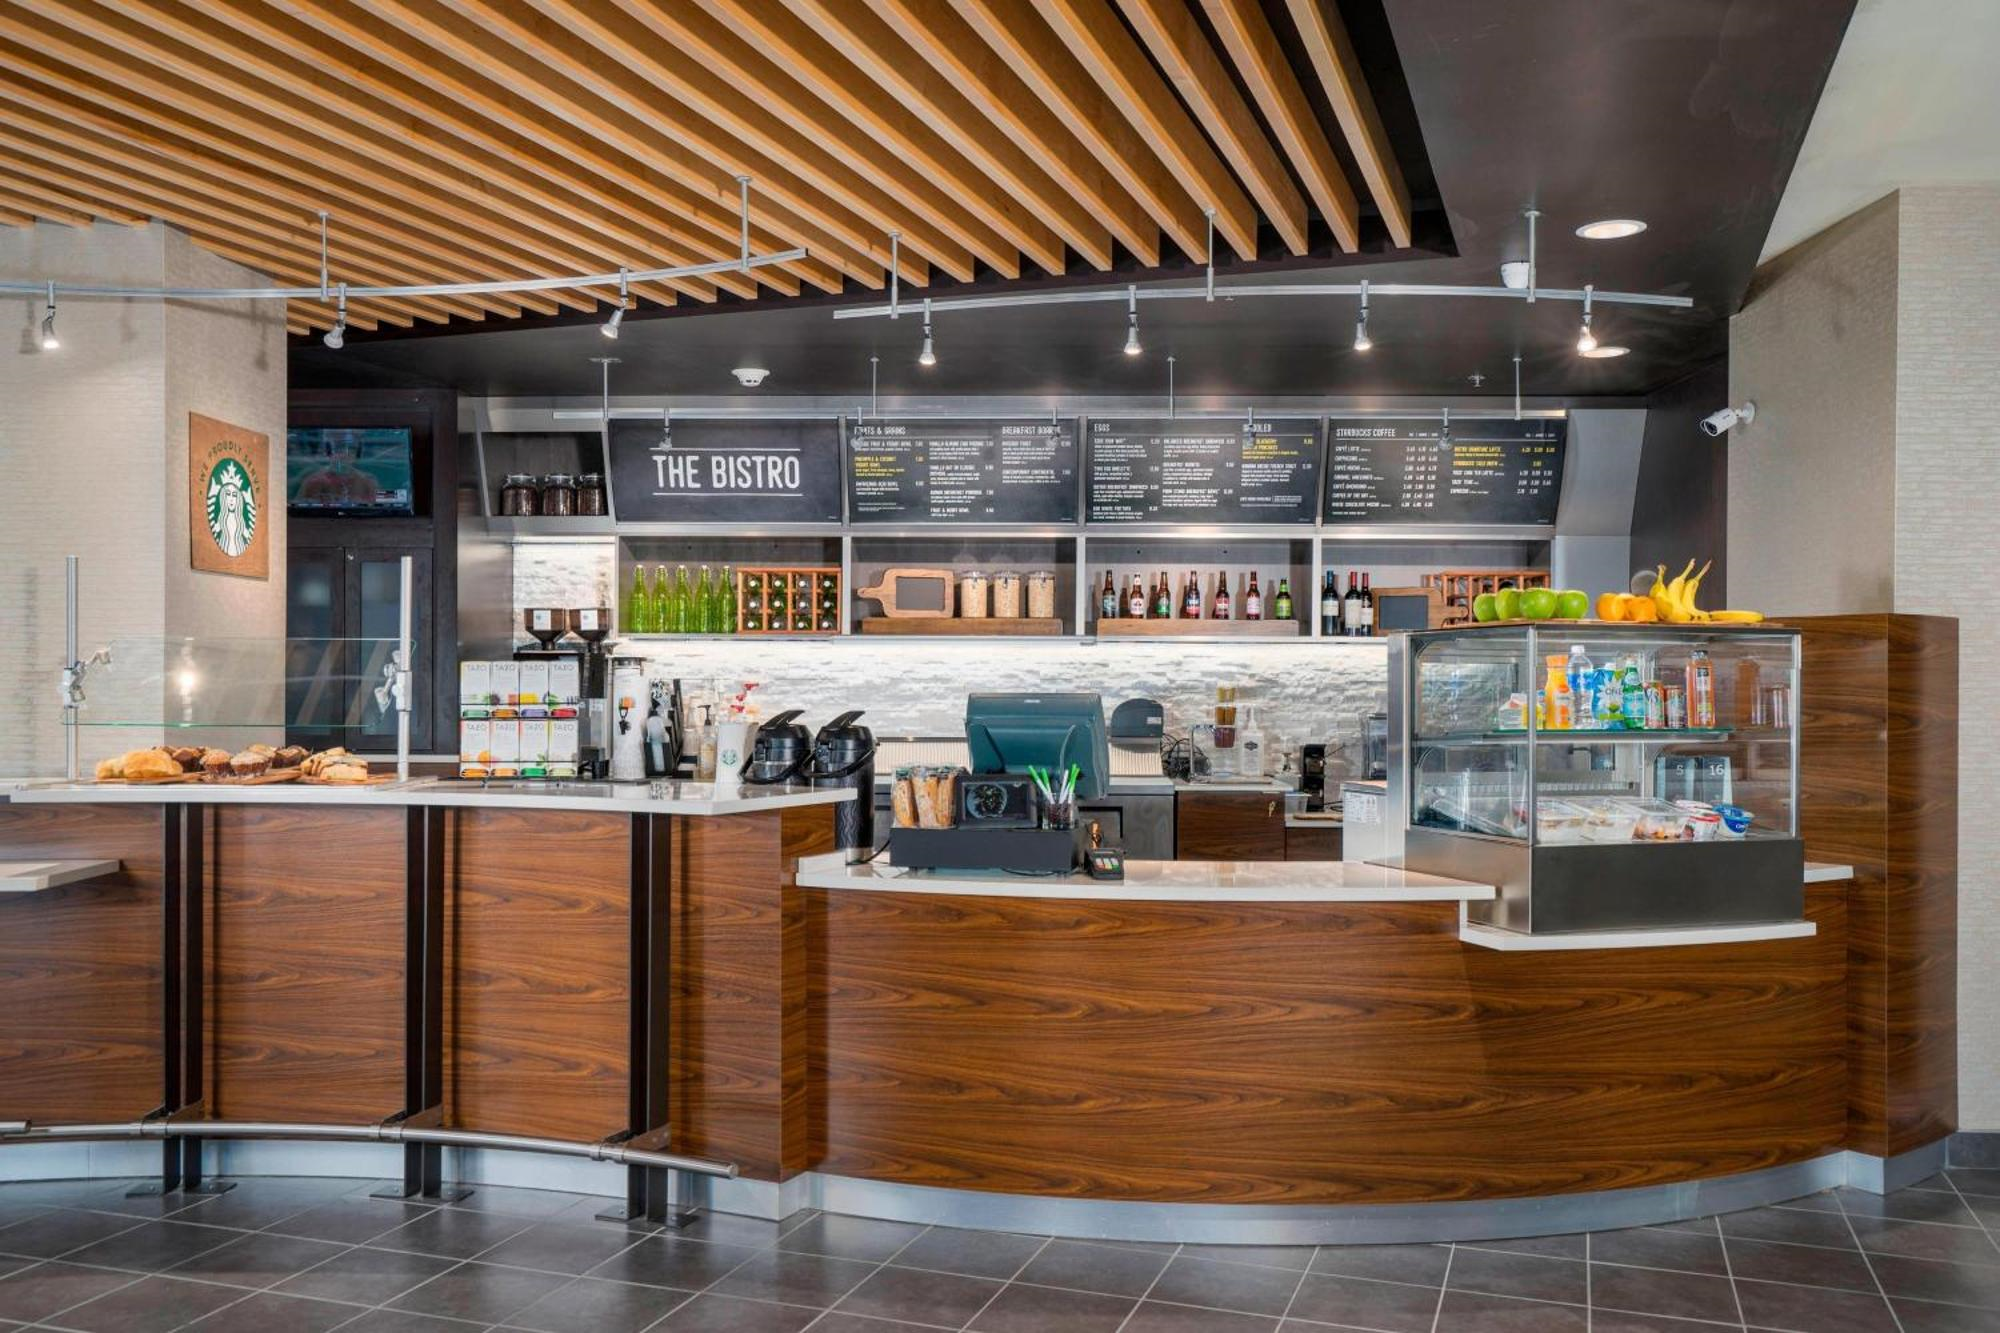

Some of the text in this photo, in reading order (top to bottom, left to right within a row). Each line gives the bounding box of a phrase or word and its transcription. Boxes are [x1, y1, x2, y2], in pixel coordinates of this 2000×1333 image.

[1094, 423, 1110, 432] EGGS
[1336, 428, 1397, 437] STARBUCKS COFFEE
[208, 441, 242, 460] PROUDLY
[652, 456, 800, 488] THE BISTRO
[1676, 765, 1684, 776] 5
[1709, 764, 1725, 776] 16
